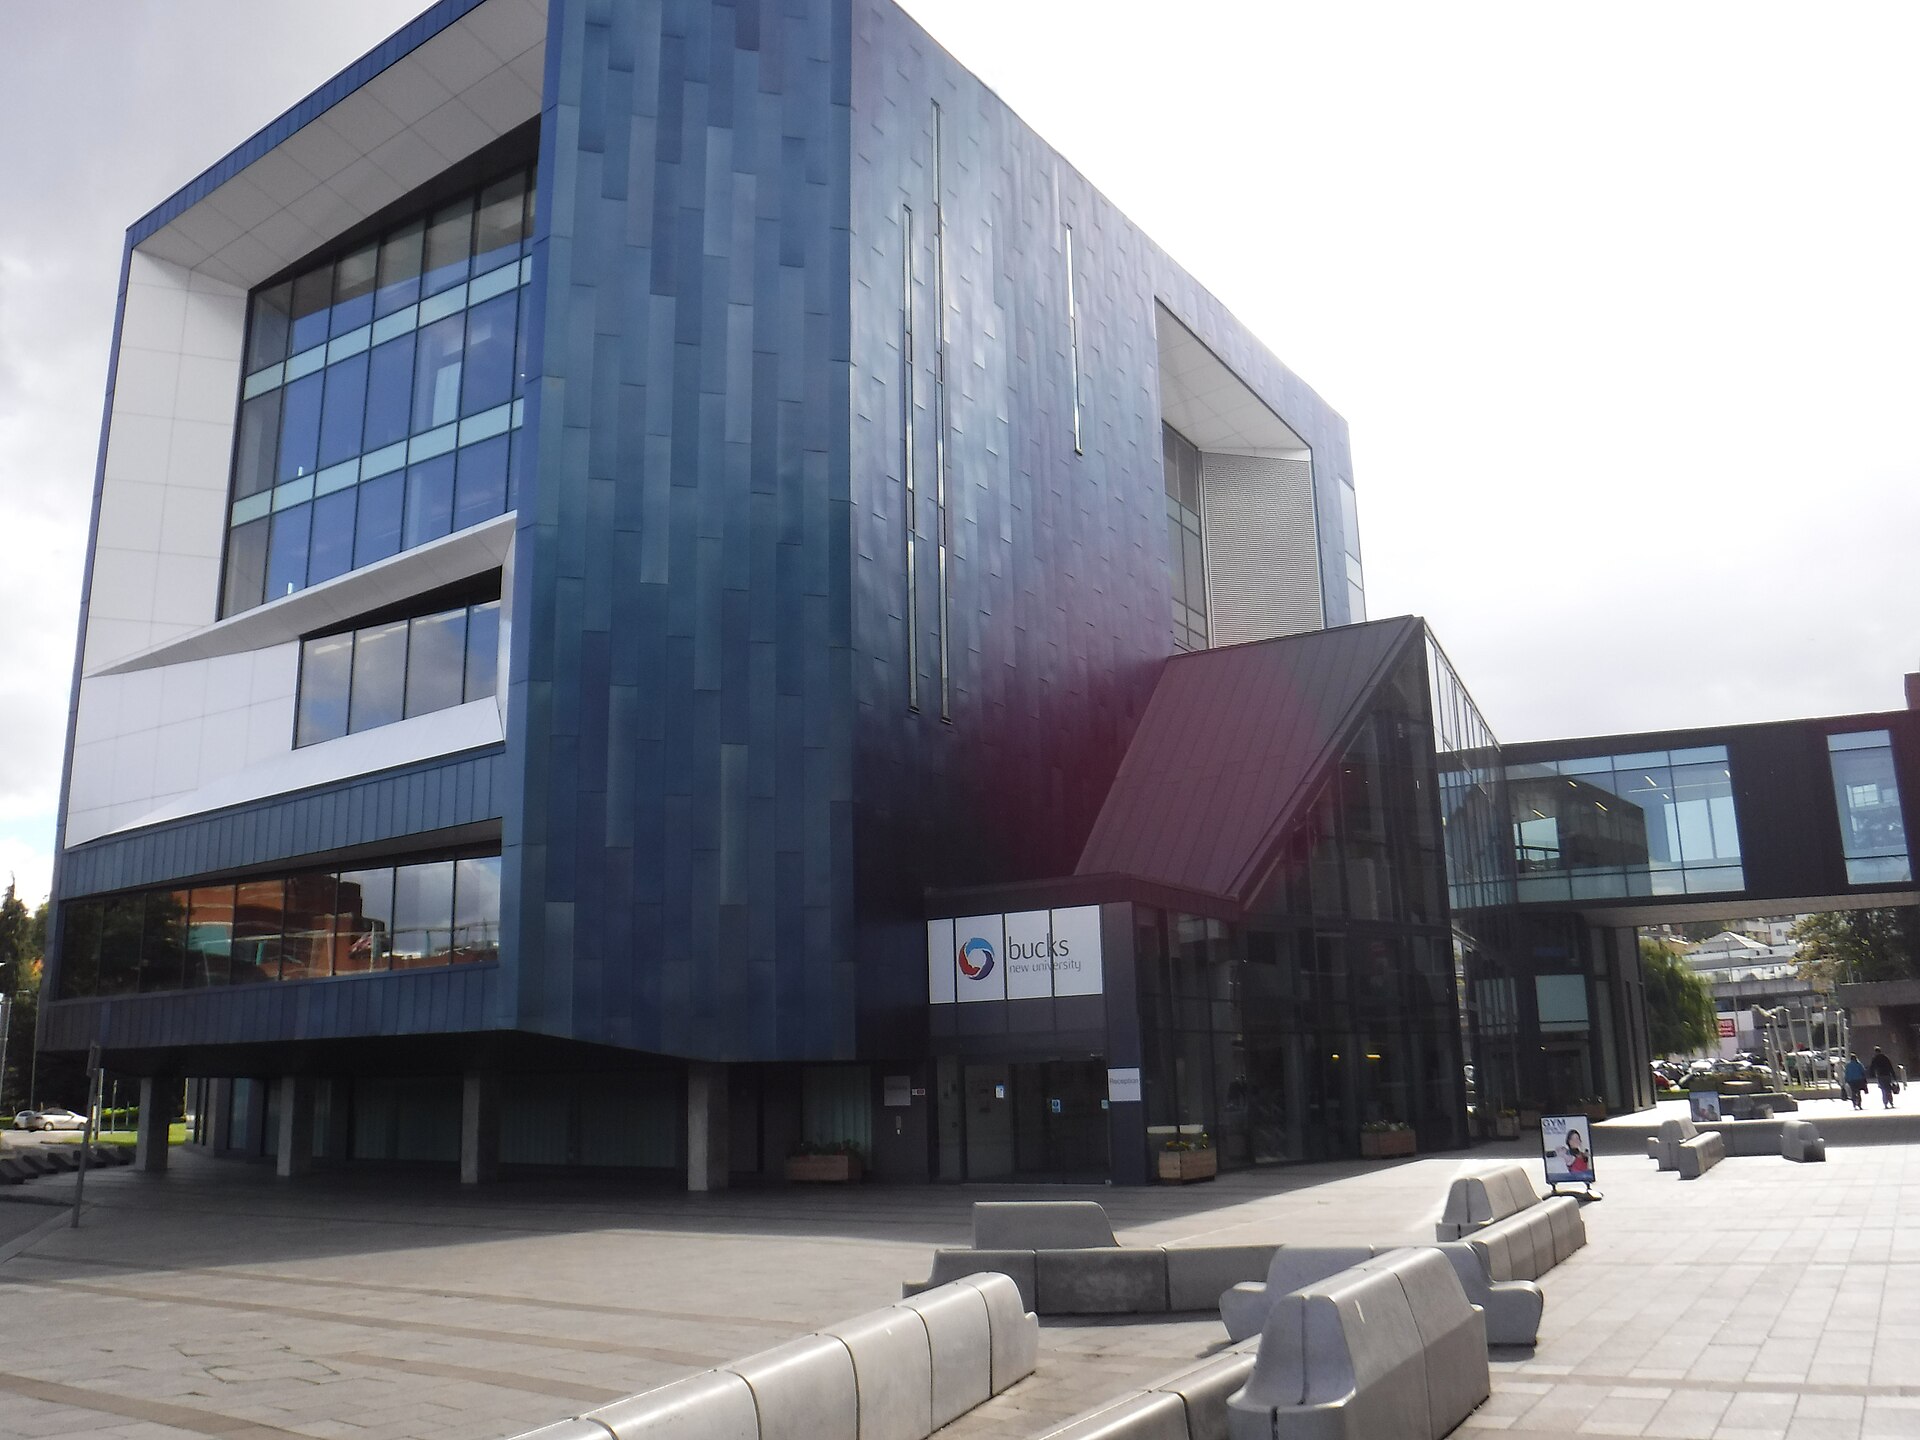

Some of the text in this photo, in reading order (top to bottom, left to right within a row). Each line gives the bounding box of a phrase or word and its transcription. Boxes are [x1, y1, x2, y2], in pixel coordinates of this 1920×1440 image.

[1008, 933, 1069, 960] bucks
[1009, 959, 1082, 973] new university
[1543, 1118, 1566, 1127] GYM
